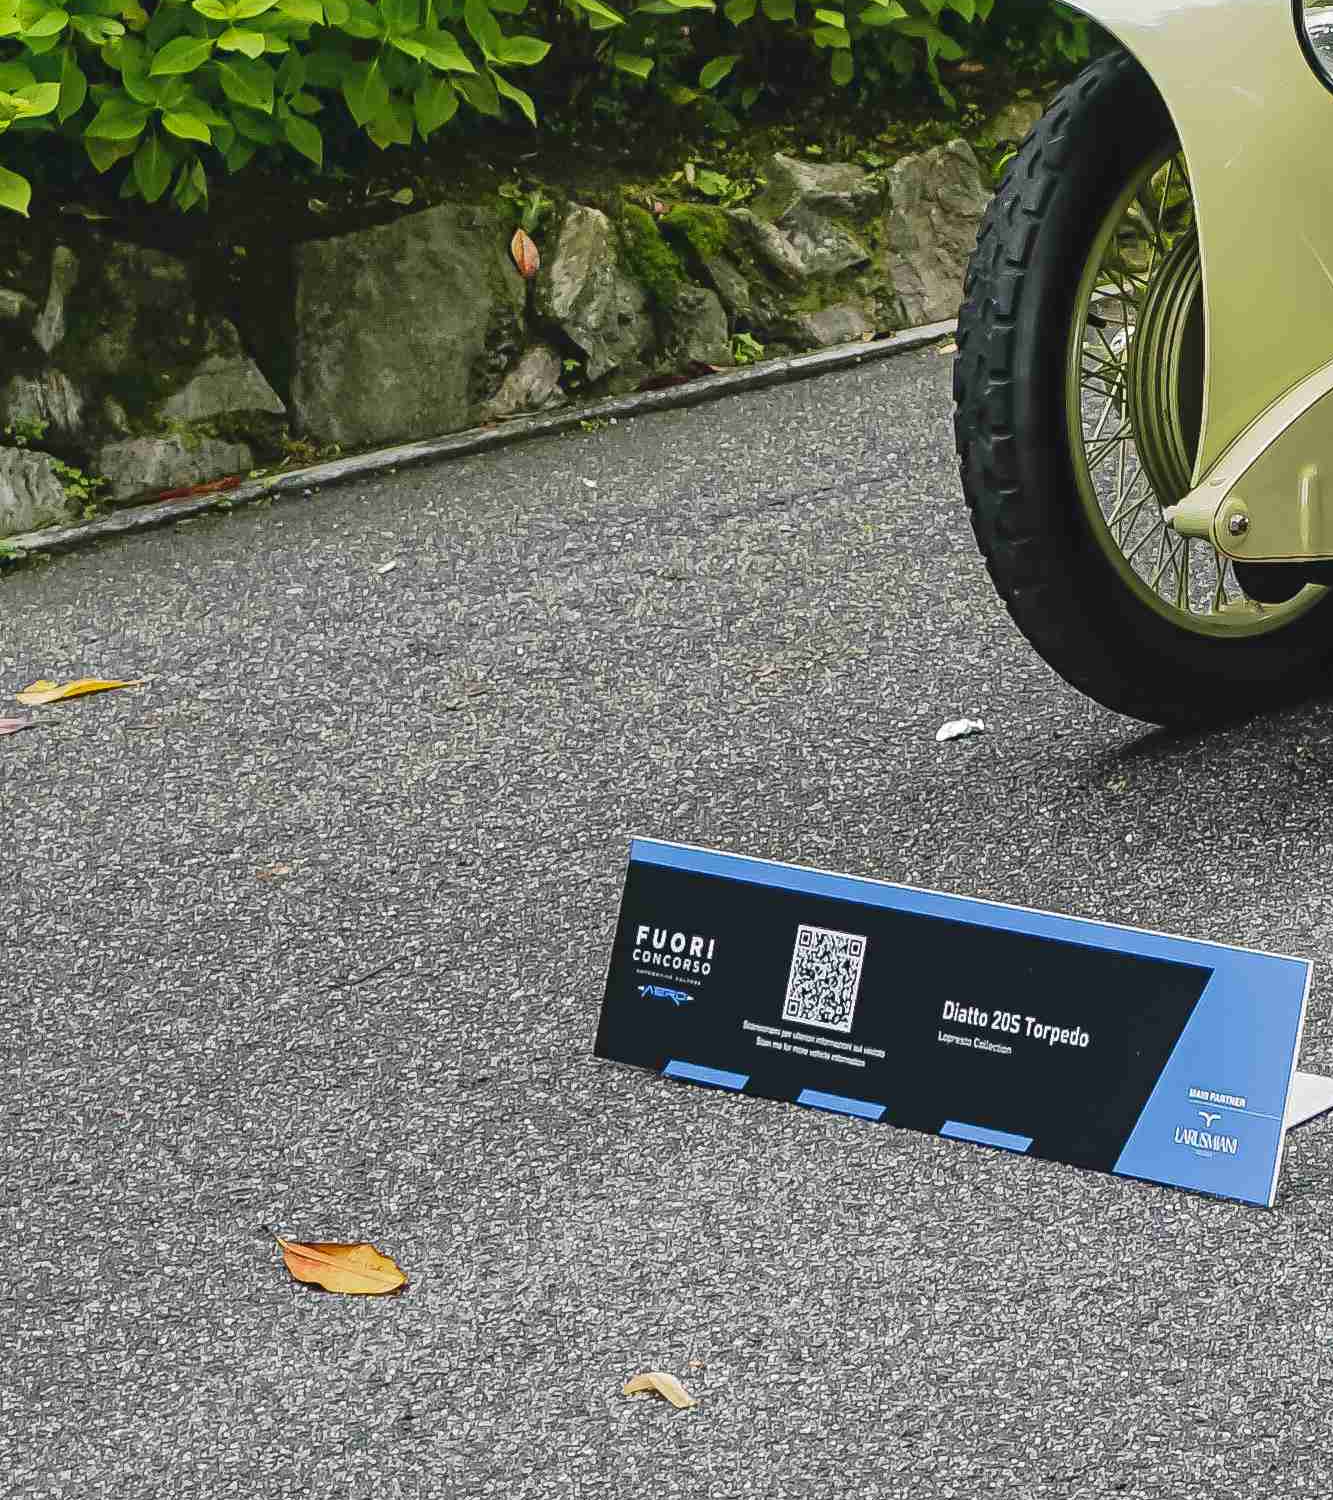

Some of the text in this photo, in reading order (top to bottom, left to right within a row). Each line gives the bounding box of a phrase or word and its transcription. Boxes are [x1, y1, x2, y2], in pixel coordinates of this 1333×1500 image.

[635, 924, 716, 960] FUORI
[632, 948, 712, 976] CONCORSO
[942, 999, 1090, 1048] Diatto 20S Torpedo
